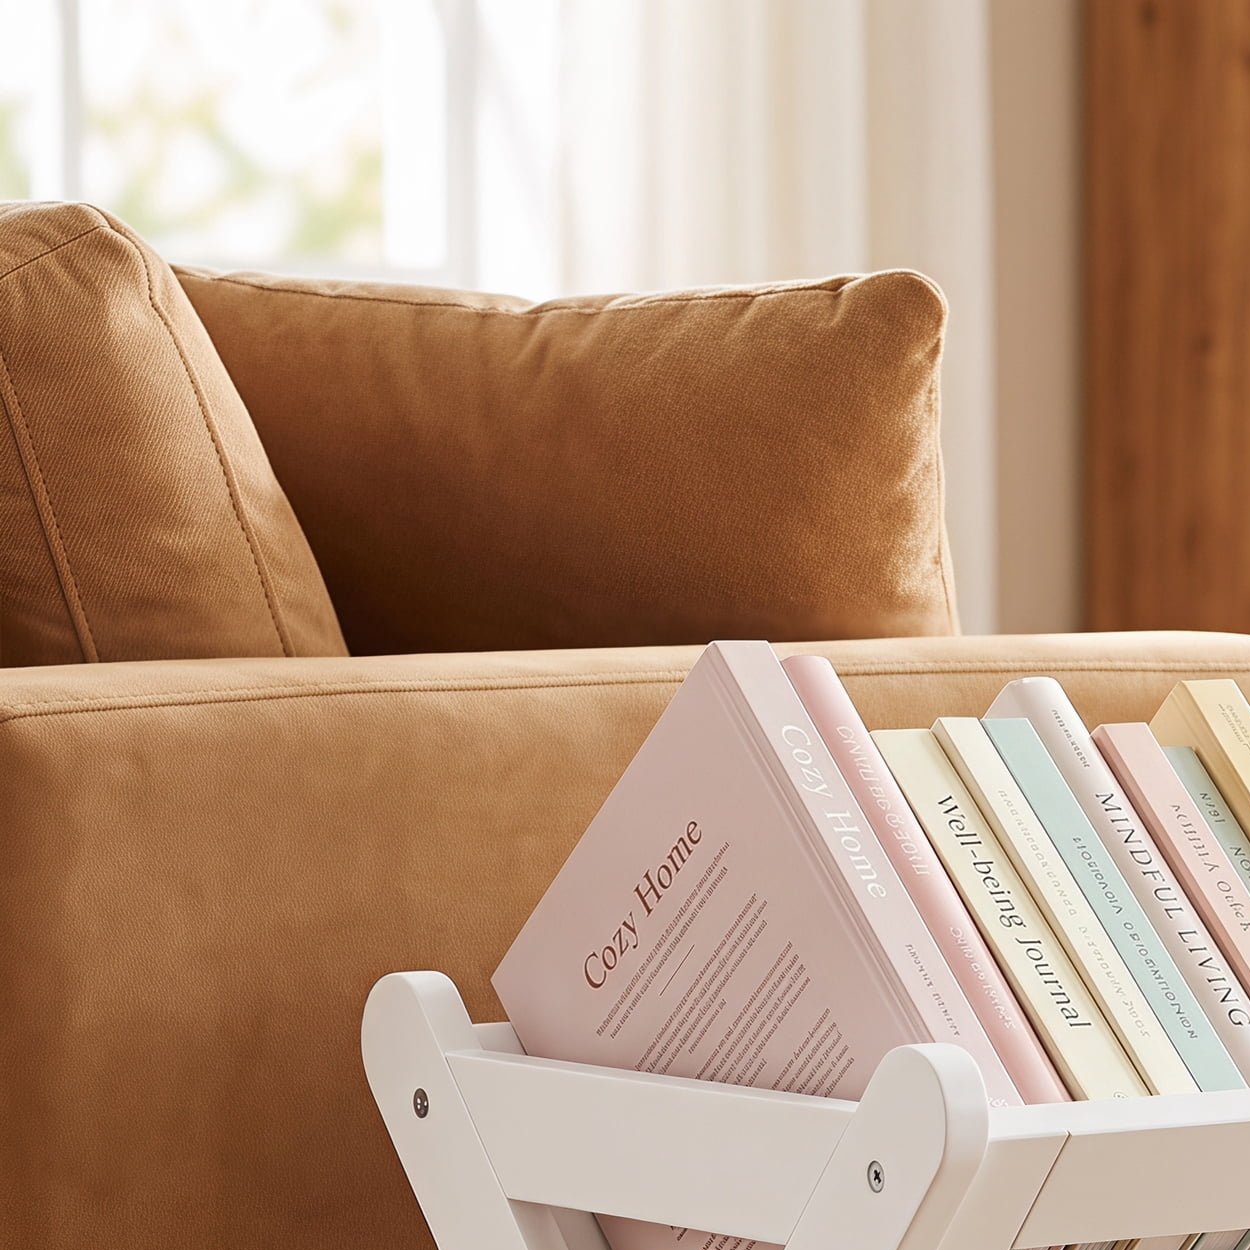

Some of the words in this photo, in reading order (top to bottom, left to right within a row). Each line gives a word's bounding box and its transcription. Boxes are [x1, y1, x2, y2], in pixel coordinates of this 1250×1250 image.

[781, 725, 833, 798] Cozy
[824, 809, 887, 898] Home
[1095, 792, 1184, 919] MINDFUL
[584, 911, 639, 989] Cozy
[633, 820, 702, 918] Home
[937, 796, 1026, 928] Well-being
[1015, 937, 1092, 1028] Journal
